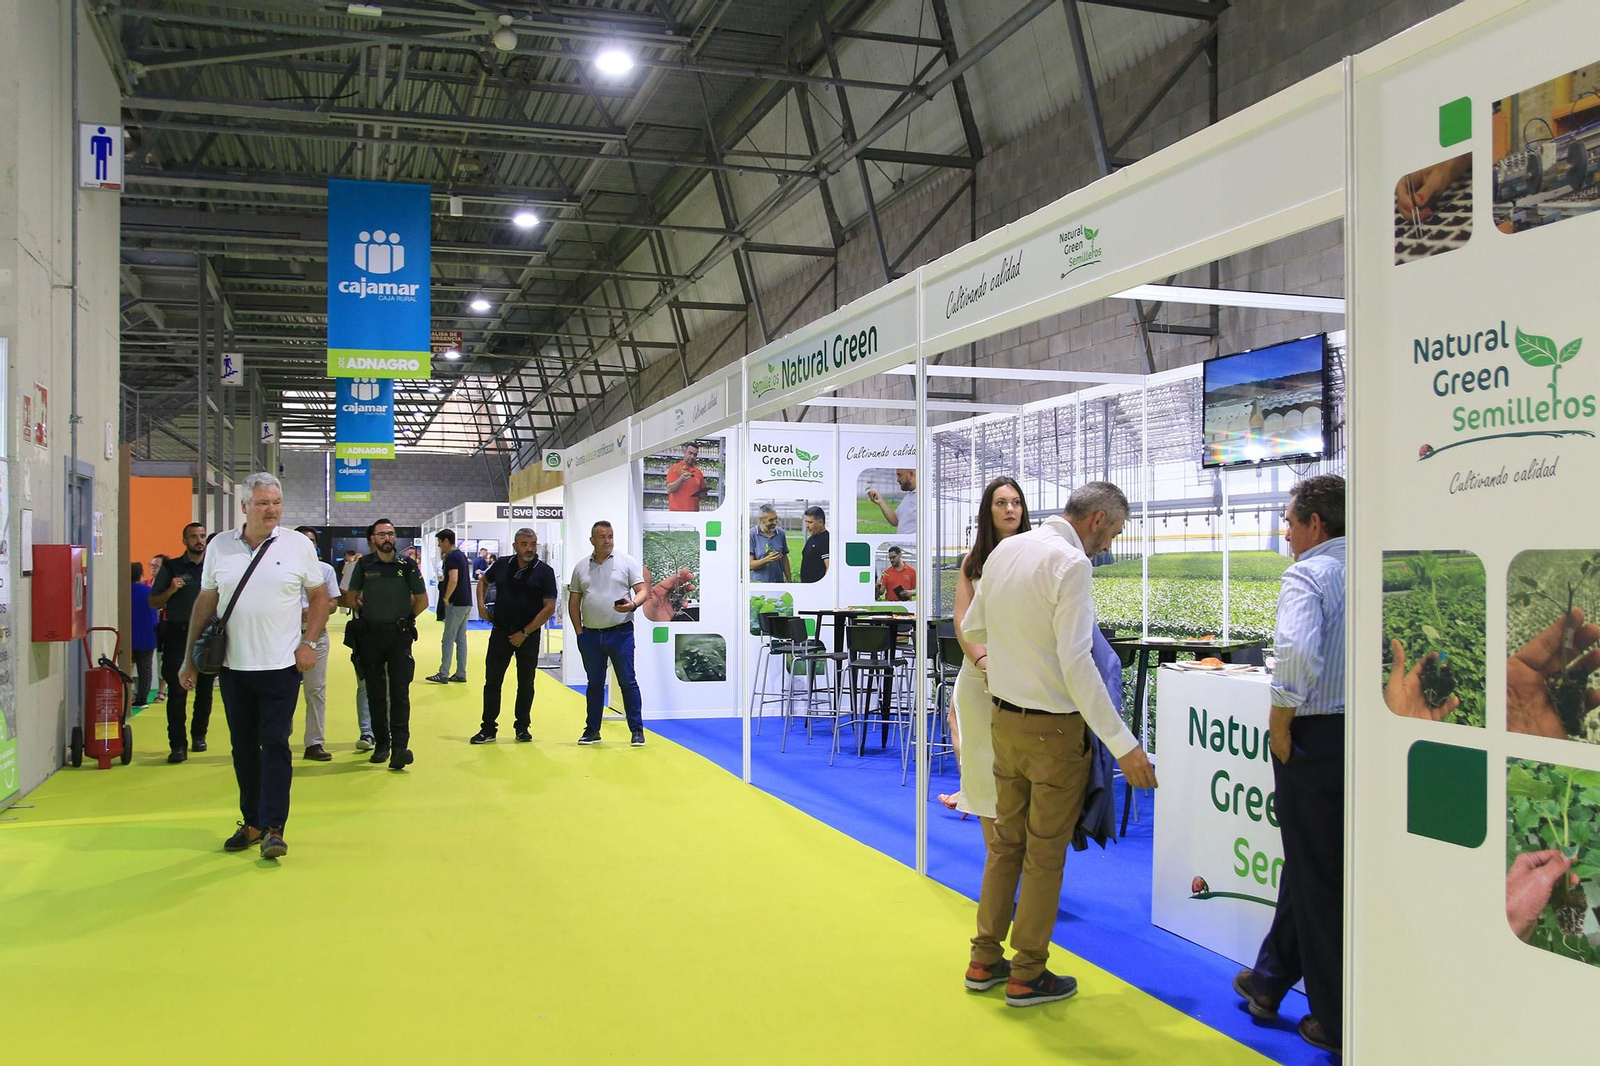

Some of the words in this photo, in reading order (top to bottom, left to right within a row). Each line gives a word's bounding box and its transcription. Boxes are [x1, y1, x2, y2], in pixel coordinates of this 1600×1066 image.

[1059, 225, 1083, 244] Natural
[1064, 240, 1083, 255] Green
[1068, 246, 1102, 267] Semilleros
[338, 276, 420, 298] cajamar
[946, 272, 987, 319] Cultivando
[990, 250, 1023, 291] calidad
[1414, 320, 1510, 364] Natural
[346, 357, 420, 371] ADNAGRO
[782, 340, 829, 390] Natural
[833, 325, 878, 368] Green
[1433, 365, 1509, 397] Green
[342, 402, 388, 415] cajamar
[1452, 394, 1596, 432] Semilleros
[347, 447, 388, 455] ADNAGRO
[753, 443, 794, 454] Natural
[846, 446, 890, 460] Cultivando
[892, 443, 917, 457] calida
[762, 455, 794, 466] Green
[770, 468, 824, 478] Semilleros
[1450, 465, 1508, 495] Cultivando
[1514, 456, 1560, 483] calidad
[1188, 706, 1271, 763] Natur
[1211, 770, 1281, 828] Gree
